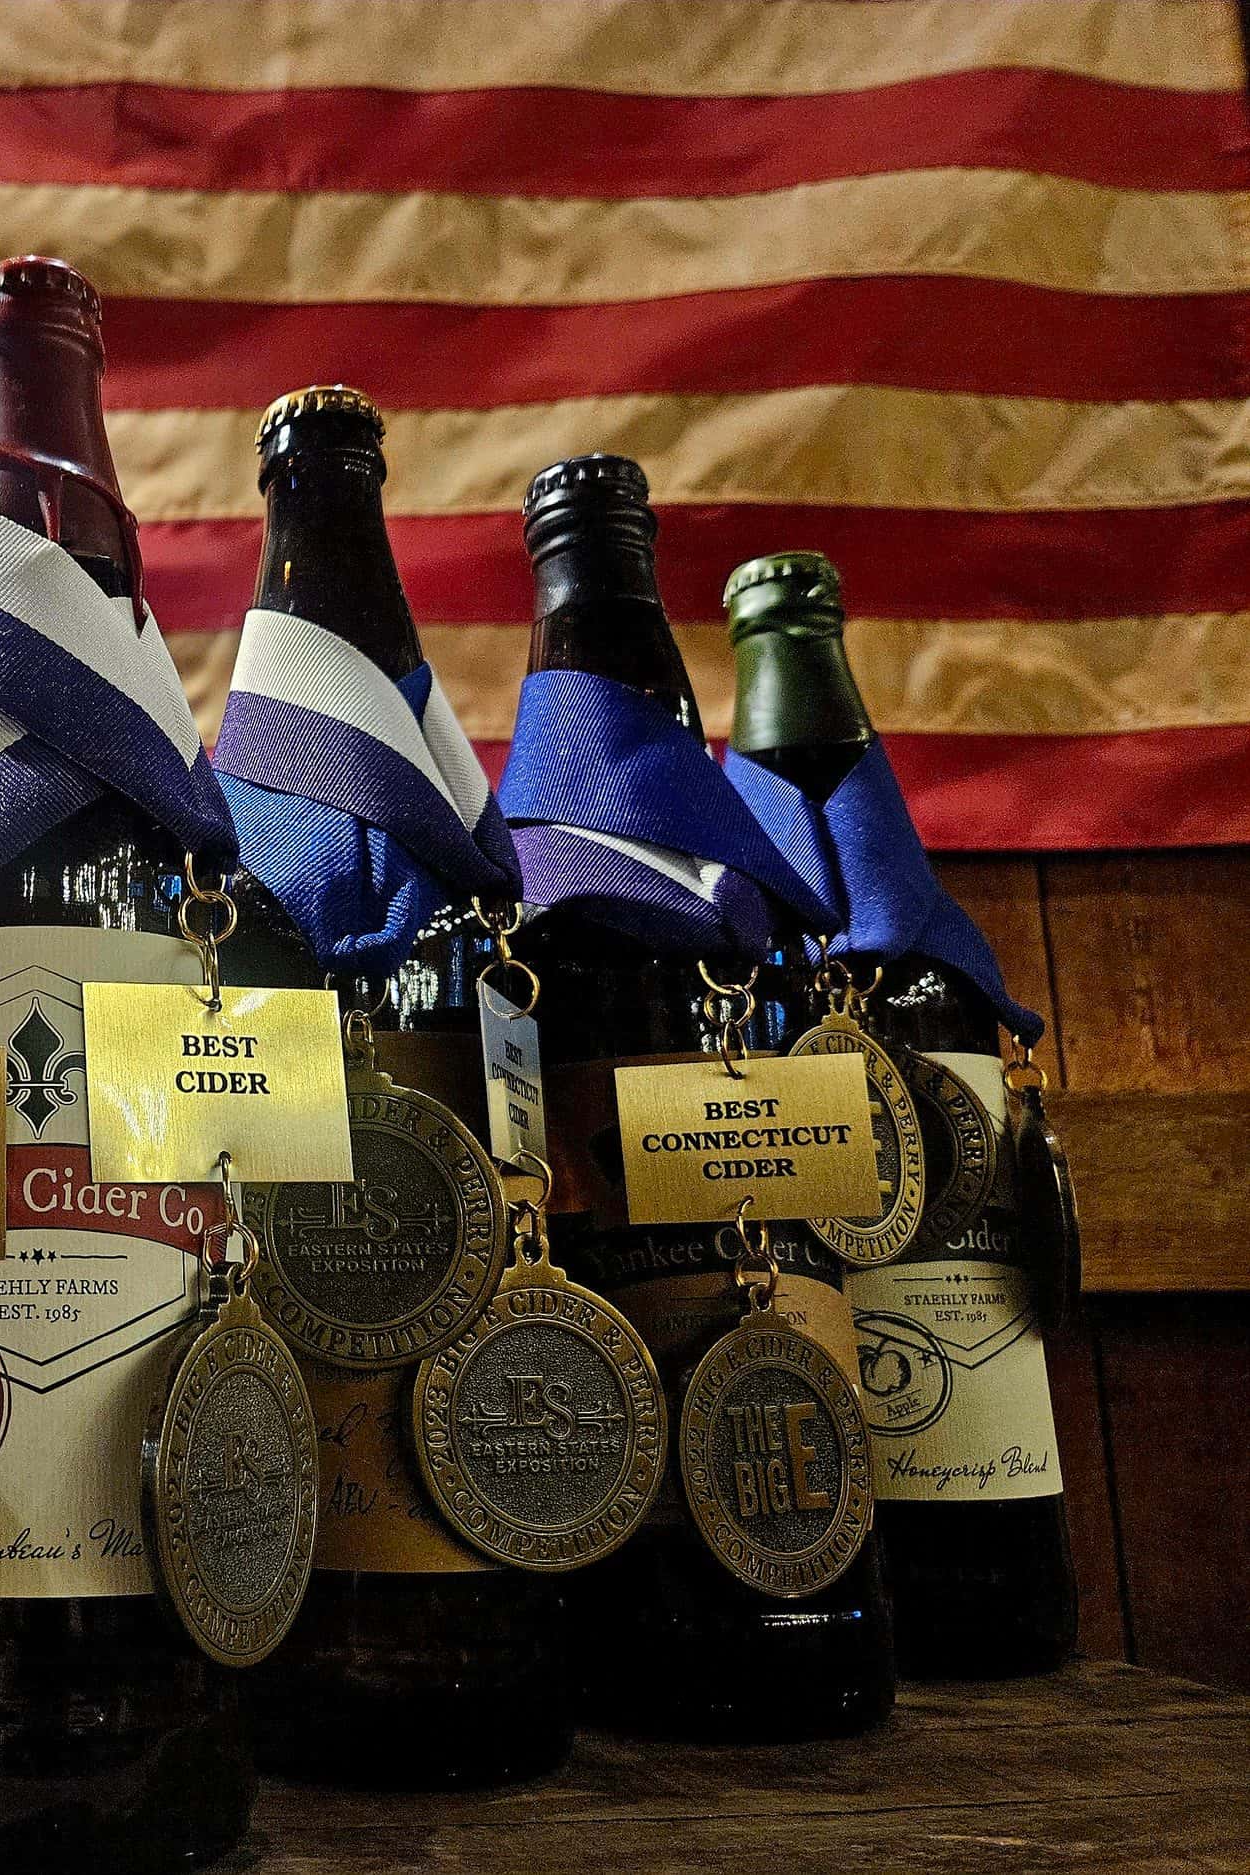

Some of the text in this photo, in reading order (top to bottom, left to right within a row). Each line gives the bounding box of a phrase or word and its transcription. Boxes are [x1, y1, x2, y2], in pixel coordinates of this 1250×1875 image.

[181, 1034, 259, 1058] BEST
[504, 1039, 523, 1067] BEST
[175, 1071, 270, 1094] CIDER
[491, 1061, 539, 1106] CONNECTICUT
[508, 1102, 530, 1131] CIDER
[704, 1098, 779, 1121] BEST
[642, 1124, 852, 1153] CONNECTICUT
[894, 1094, 922, 1185] PERRY
[348, 1096, 423, 1133] IDER
[455, 1158, 491, 1269] PERRY
[702, 1157, 797, 1180] CIDER
[813, 1198, 917, 1258] OMPETITION
[288, 1241, 450, 1258] EASTERN STATES
[715, 1227, 798, 1262] Cer
[311, 1258, 425, 1274] EXPOSITION
[55, 1279, 118, 1296] FARMS
[904, 1293, 1007, 1306] STAEHLY FARMS
[45, 1305, 81, 1323] 1985
[264, 1281, 476, 1357] COMPETITION
[934, 1310, 987, 1323] EST. 1985
[425, 1388, 456, 1471] 2023
[507, 1288, 597, 1332] CIDER
[601, 1328, 624, 1355] &
[621, 1358, 658, 1467] PERRY
[693, 1365, 725, 1416] BIG
[726, 1345, 743, 1368] E
[748, 1335, 814, 1371] CIDER
[818, 1367, 836, 1388] &
[886, 1397, 921, 1417] Apple
[727, 1404, 784, 1453] THE
[470, 1439, 622, 1457] EASTERN STATES
[496, 1457, 601, 1474] EXPOSITION
[888, 1446, 1048, 1491] Honeycrisp Blend
[734, 1458, 792, 1518] BIG
[453, 1484, 646, 1558] COMPETITION
[89, 1518, 146, 1557] Ma
[714, 1510, 863, 1588] COMPETITION
